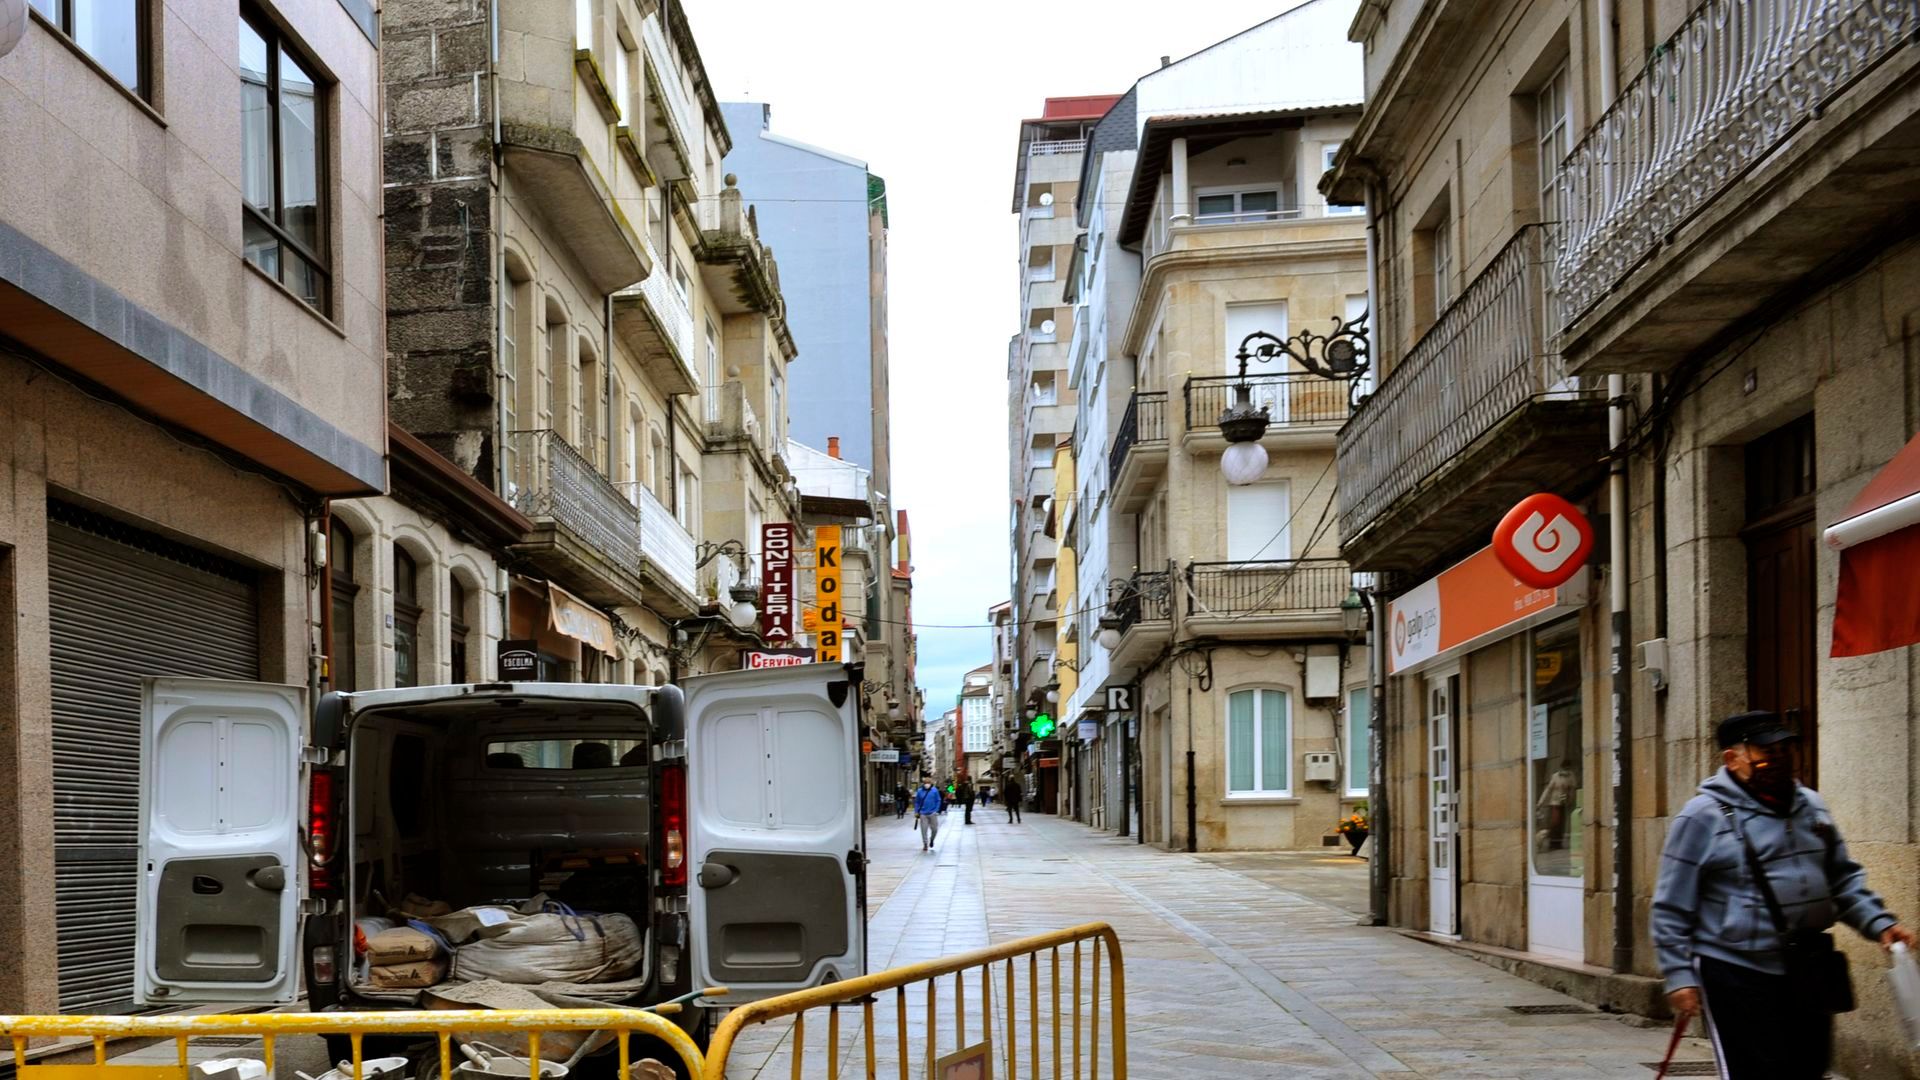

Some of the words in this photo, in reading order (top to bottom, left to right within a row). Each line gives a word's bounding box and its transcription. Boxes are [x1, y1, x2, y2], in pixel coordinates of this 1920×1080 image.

[765, 528, 789, 636] CONFITERIA
[1407, 610, 1423, 643] galp
[1424, 607, 1436, 637] gas
[1108, 687, 1130, 710] R
